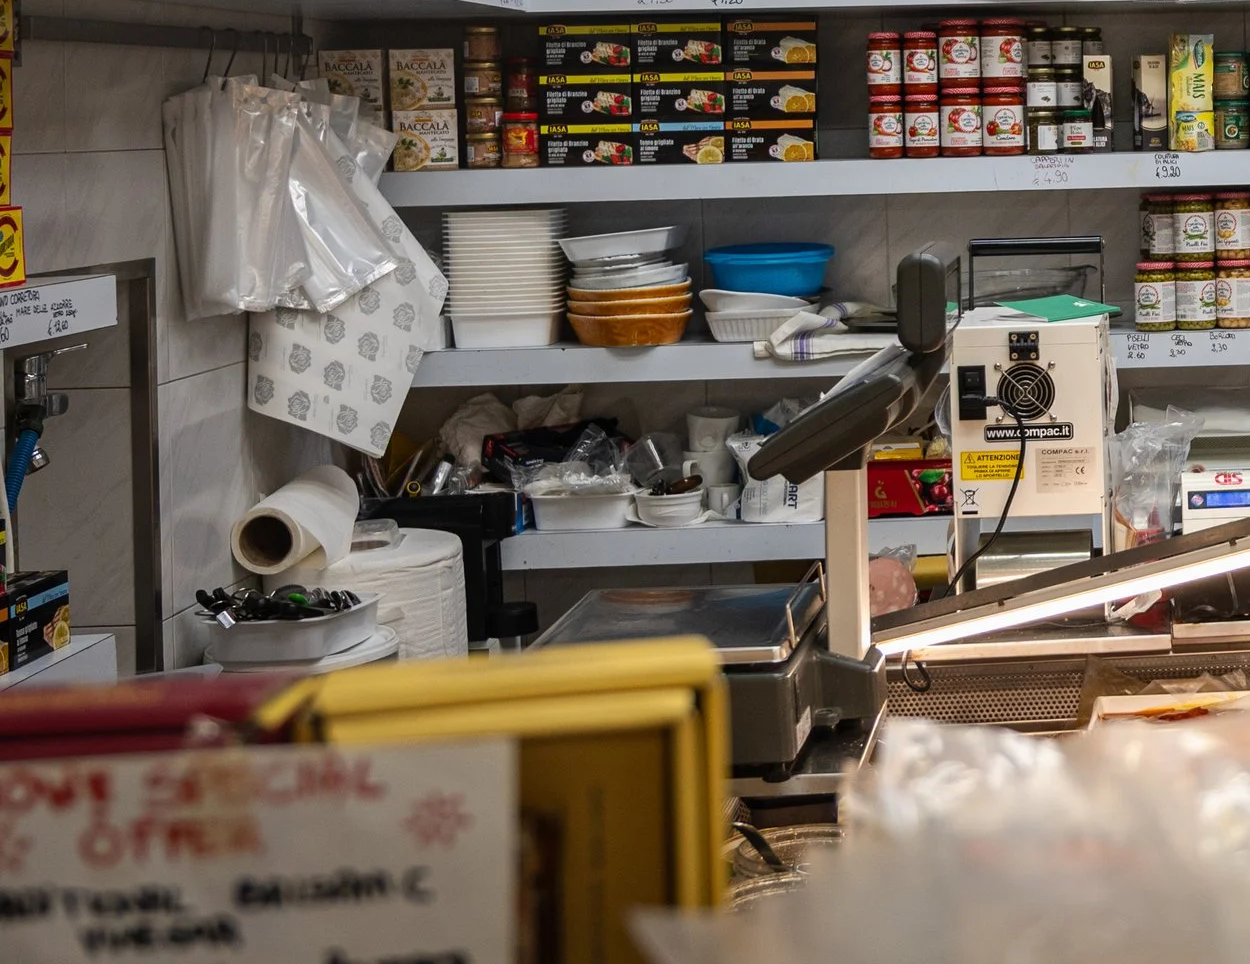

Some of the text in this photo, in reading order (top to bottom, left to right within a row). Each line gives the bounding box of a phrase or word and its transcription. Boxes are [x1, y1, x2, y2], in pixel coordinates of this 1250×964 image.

[639, 24, 656, 32] IASA
[735, 23, 752, 31] IASA
[324, 61, 372, 72] BACCALÀ
[396, 59, 446, 70] BACCALÀ
[1088, 61, 1105, 69] IASA
[548, 76, 566, 84] IASA
[640, 74, 659, 82] IASA
[734, 72, 751, 80] IASA
[1192, 72, 1204, 100] MAIS
[400, 120, 450, 131] BACCALÀ
[641, 124, 658, 132] IASA
[733, 122, 751, 130] IASA
[550, 126, 567, 134] IASA
[1042, 448, 1072, 456] COMPAC
[976, 454, 1020, 462] ATTENZIONE
